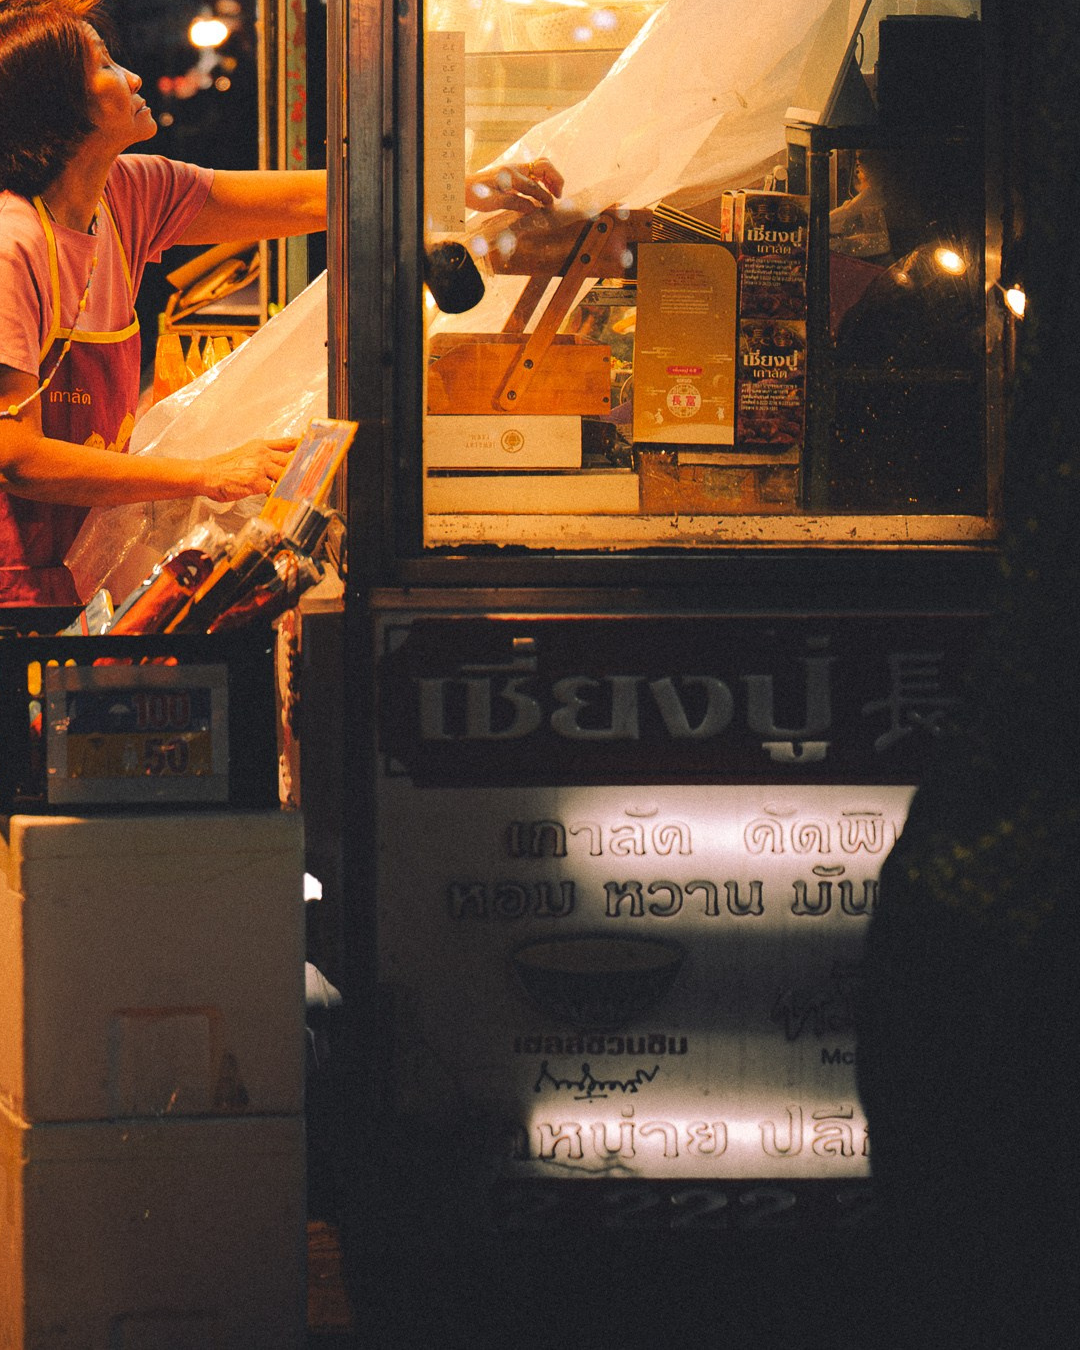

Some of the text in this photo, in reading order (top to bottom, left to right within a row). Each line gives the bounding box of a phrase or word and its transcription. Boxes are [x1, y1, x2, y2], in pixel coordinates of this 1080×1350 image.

[134, 692, 191, 729] 100
[413, 634, 837, 763] เชี่ยงปู่
[143, 737, 190, 775] 50
[604, 879, 765, 918] หวาน
